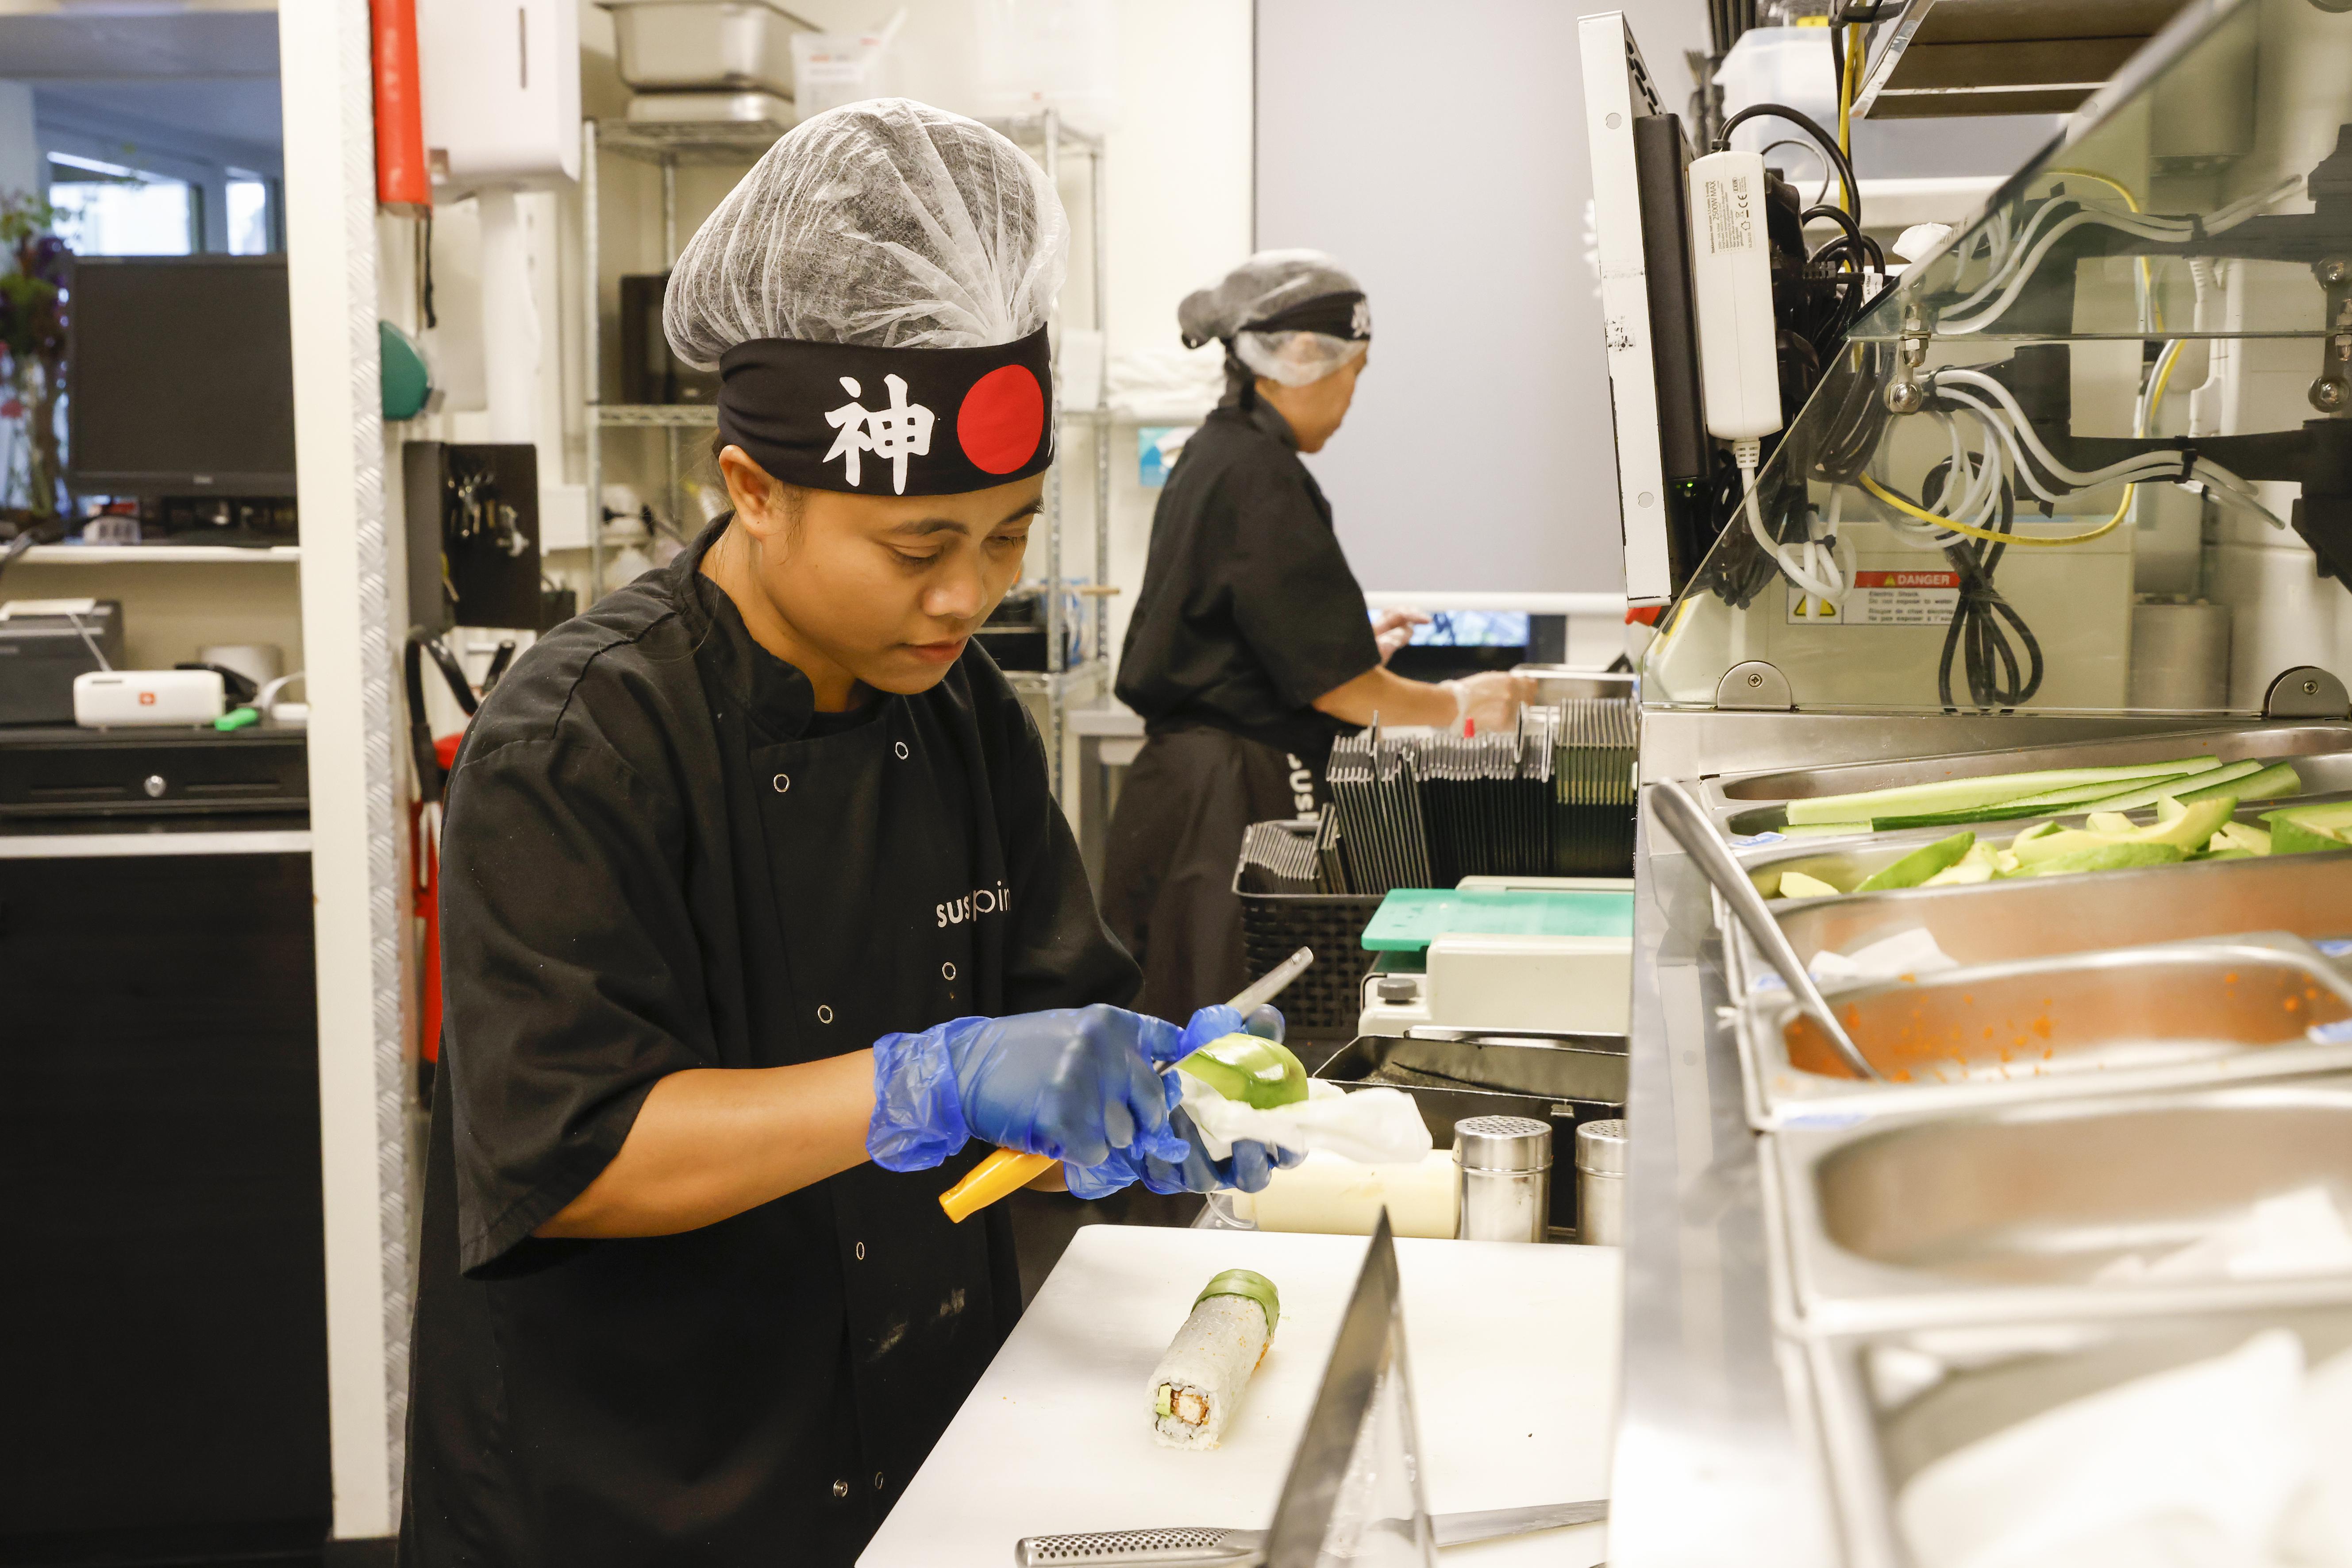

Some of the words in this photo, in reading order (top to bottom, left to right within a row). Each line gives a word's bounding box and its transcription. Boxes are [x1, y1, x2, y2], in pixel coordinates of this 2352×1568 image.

[1711, 197, 1719, 220] 2500W
[822, 373, 935, 496] 神
[1897, 574, 1950, 585] DANGER
